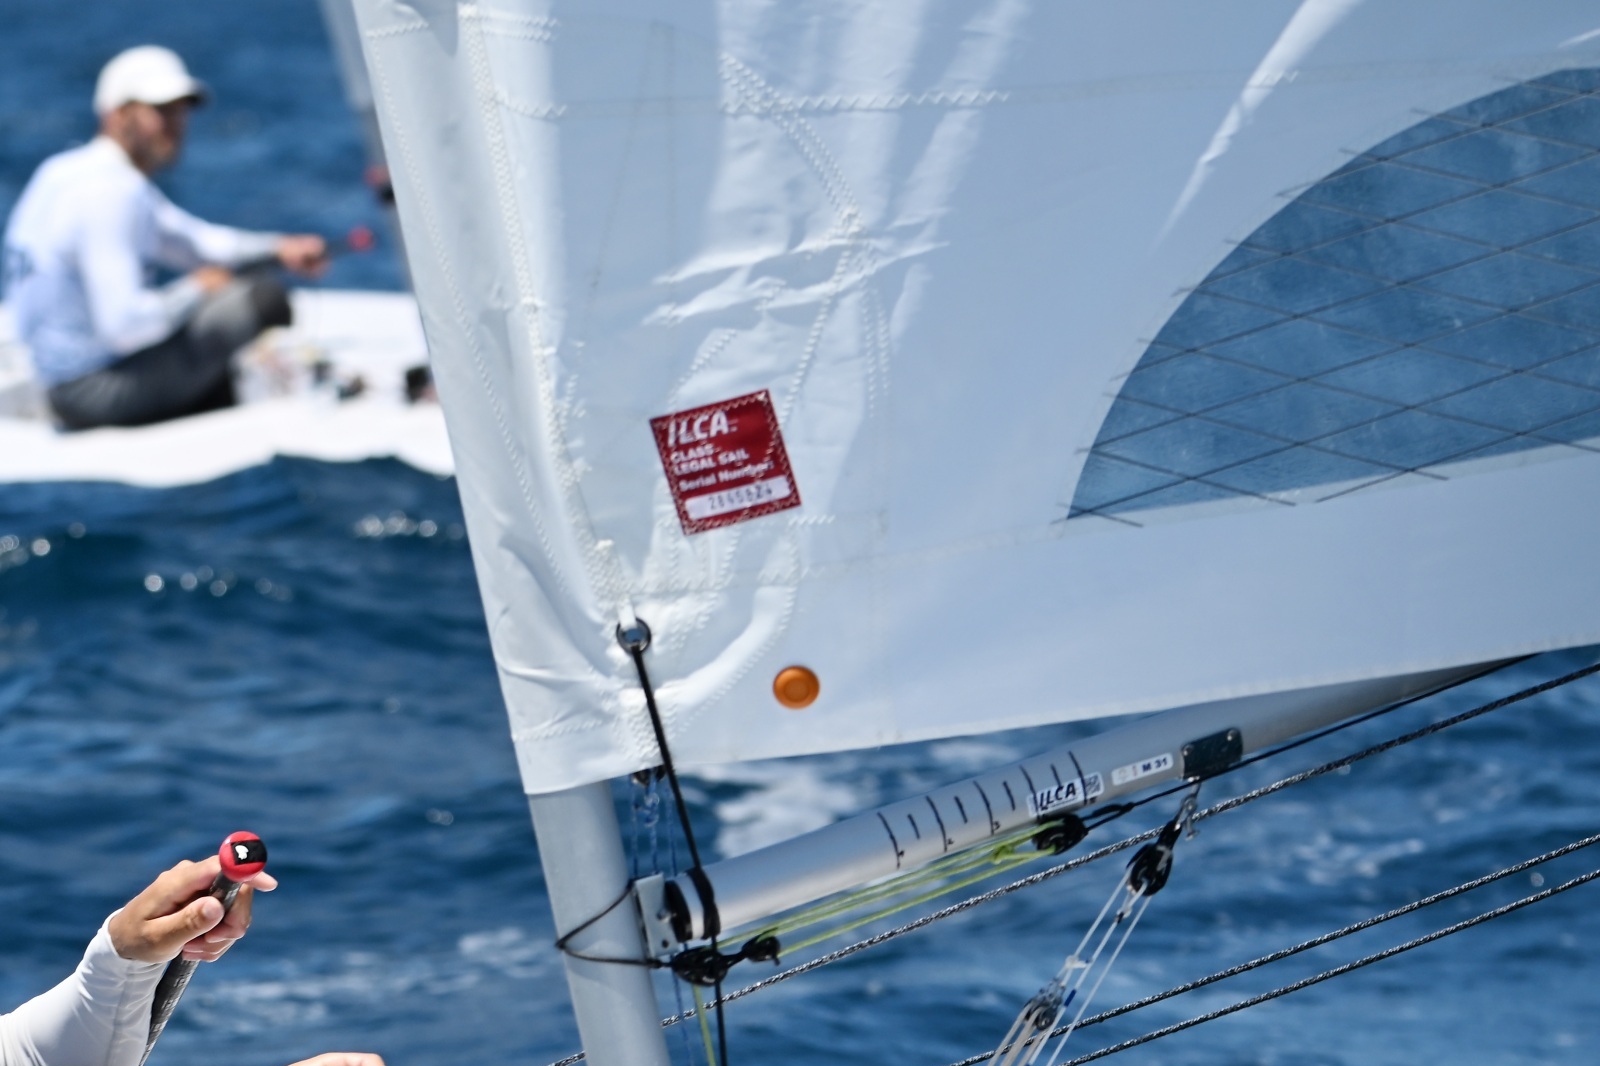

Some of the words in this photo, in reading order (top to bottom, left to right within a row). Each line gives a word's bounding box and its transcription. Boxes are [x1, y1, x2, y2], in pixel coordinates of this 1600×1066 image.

[667, 410, 729, 448] ILCA
[670, 443, 715, 464] CLASS
[673, 457, 717, 476] LEGAL
[718, 448, 750, 465] SAIL
[679, 473, 717, 492] Serial
[1039, 782, 1076, 808] ILCA
